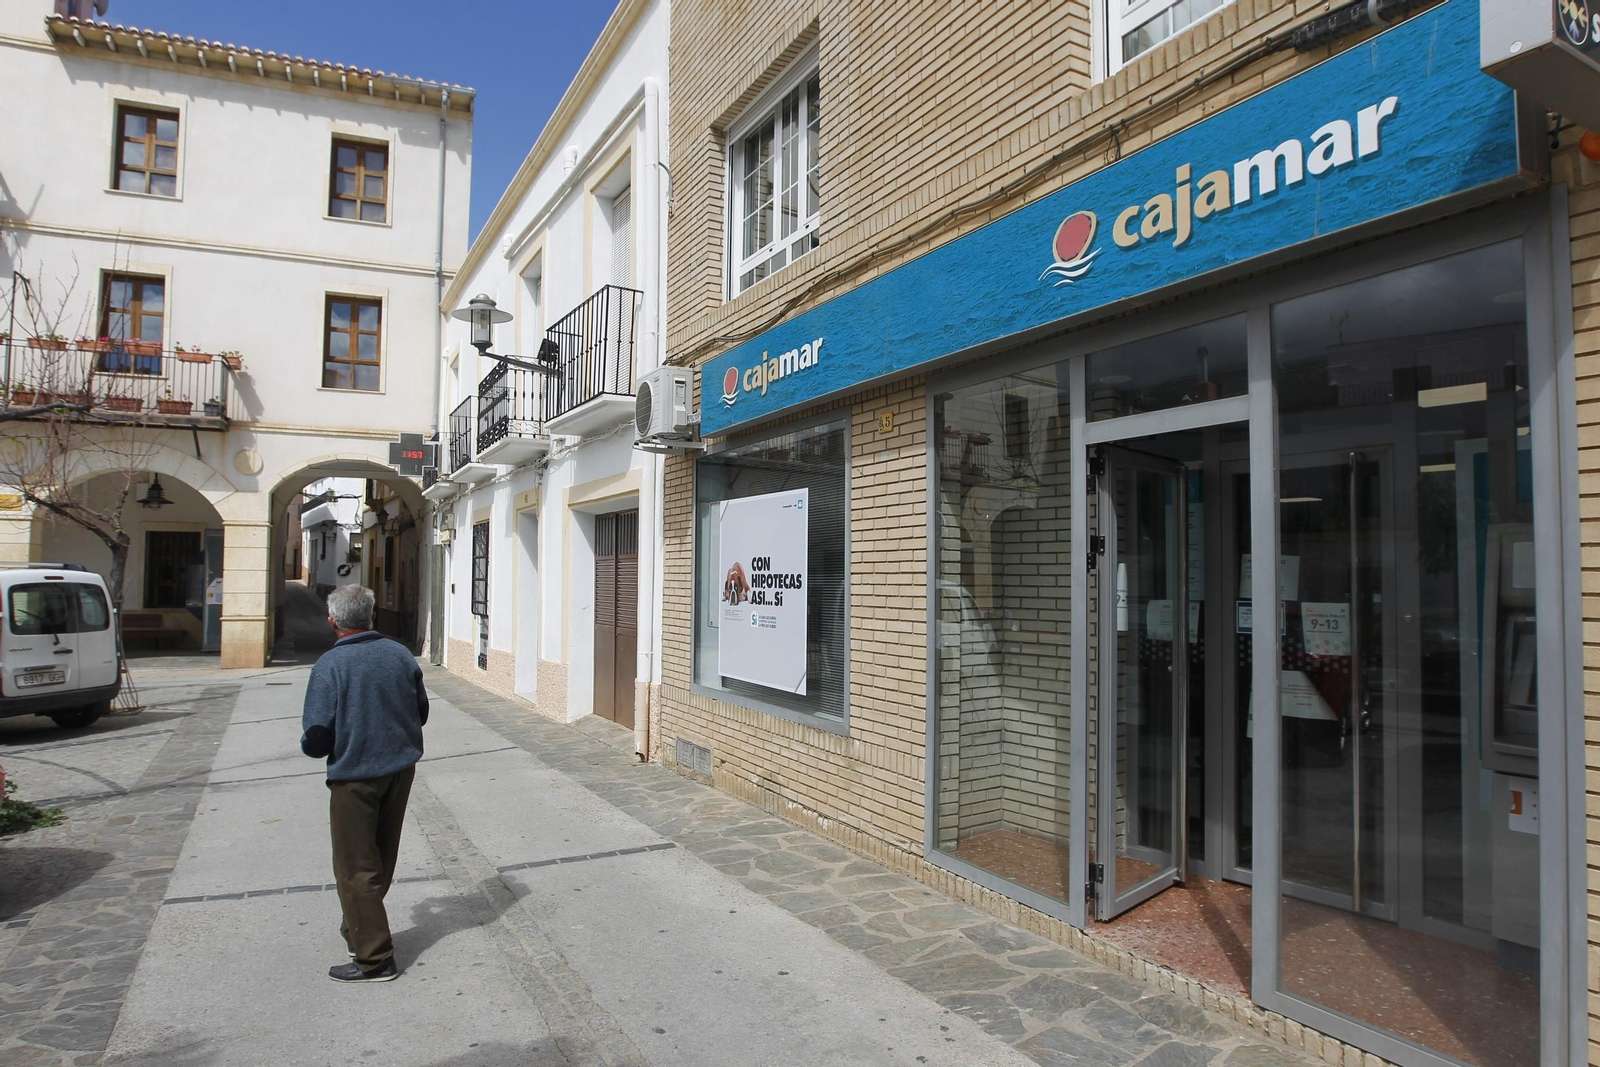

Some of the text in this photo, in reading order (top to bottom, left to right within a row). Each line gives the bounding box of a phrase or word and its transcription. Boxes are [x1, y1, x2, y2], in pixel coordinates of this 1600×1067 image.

[1112, 96, 1398, 247] cajamar
[743, 337, 824, 396] cajamar
[751, 556, 771, 572] CON
[751, 573, 802, 589] HIPOTECAS
[1311, 618, 1339, 630] 9-13
[23, 674, 44, 685] 8917
